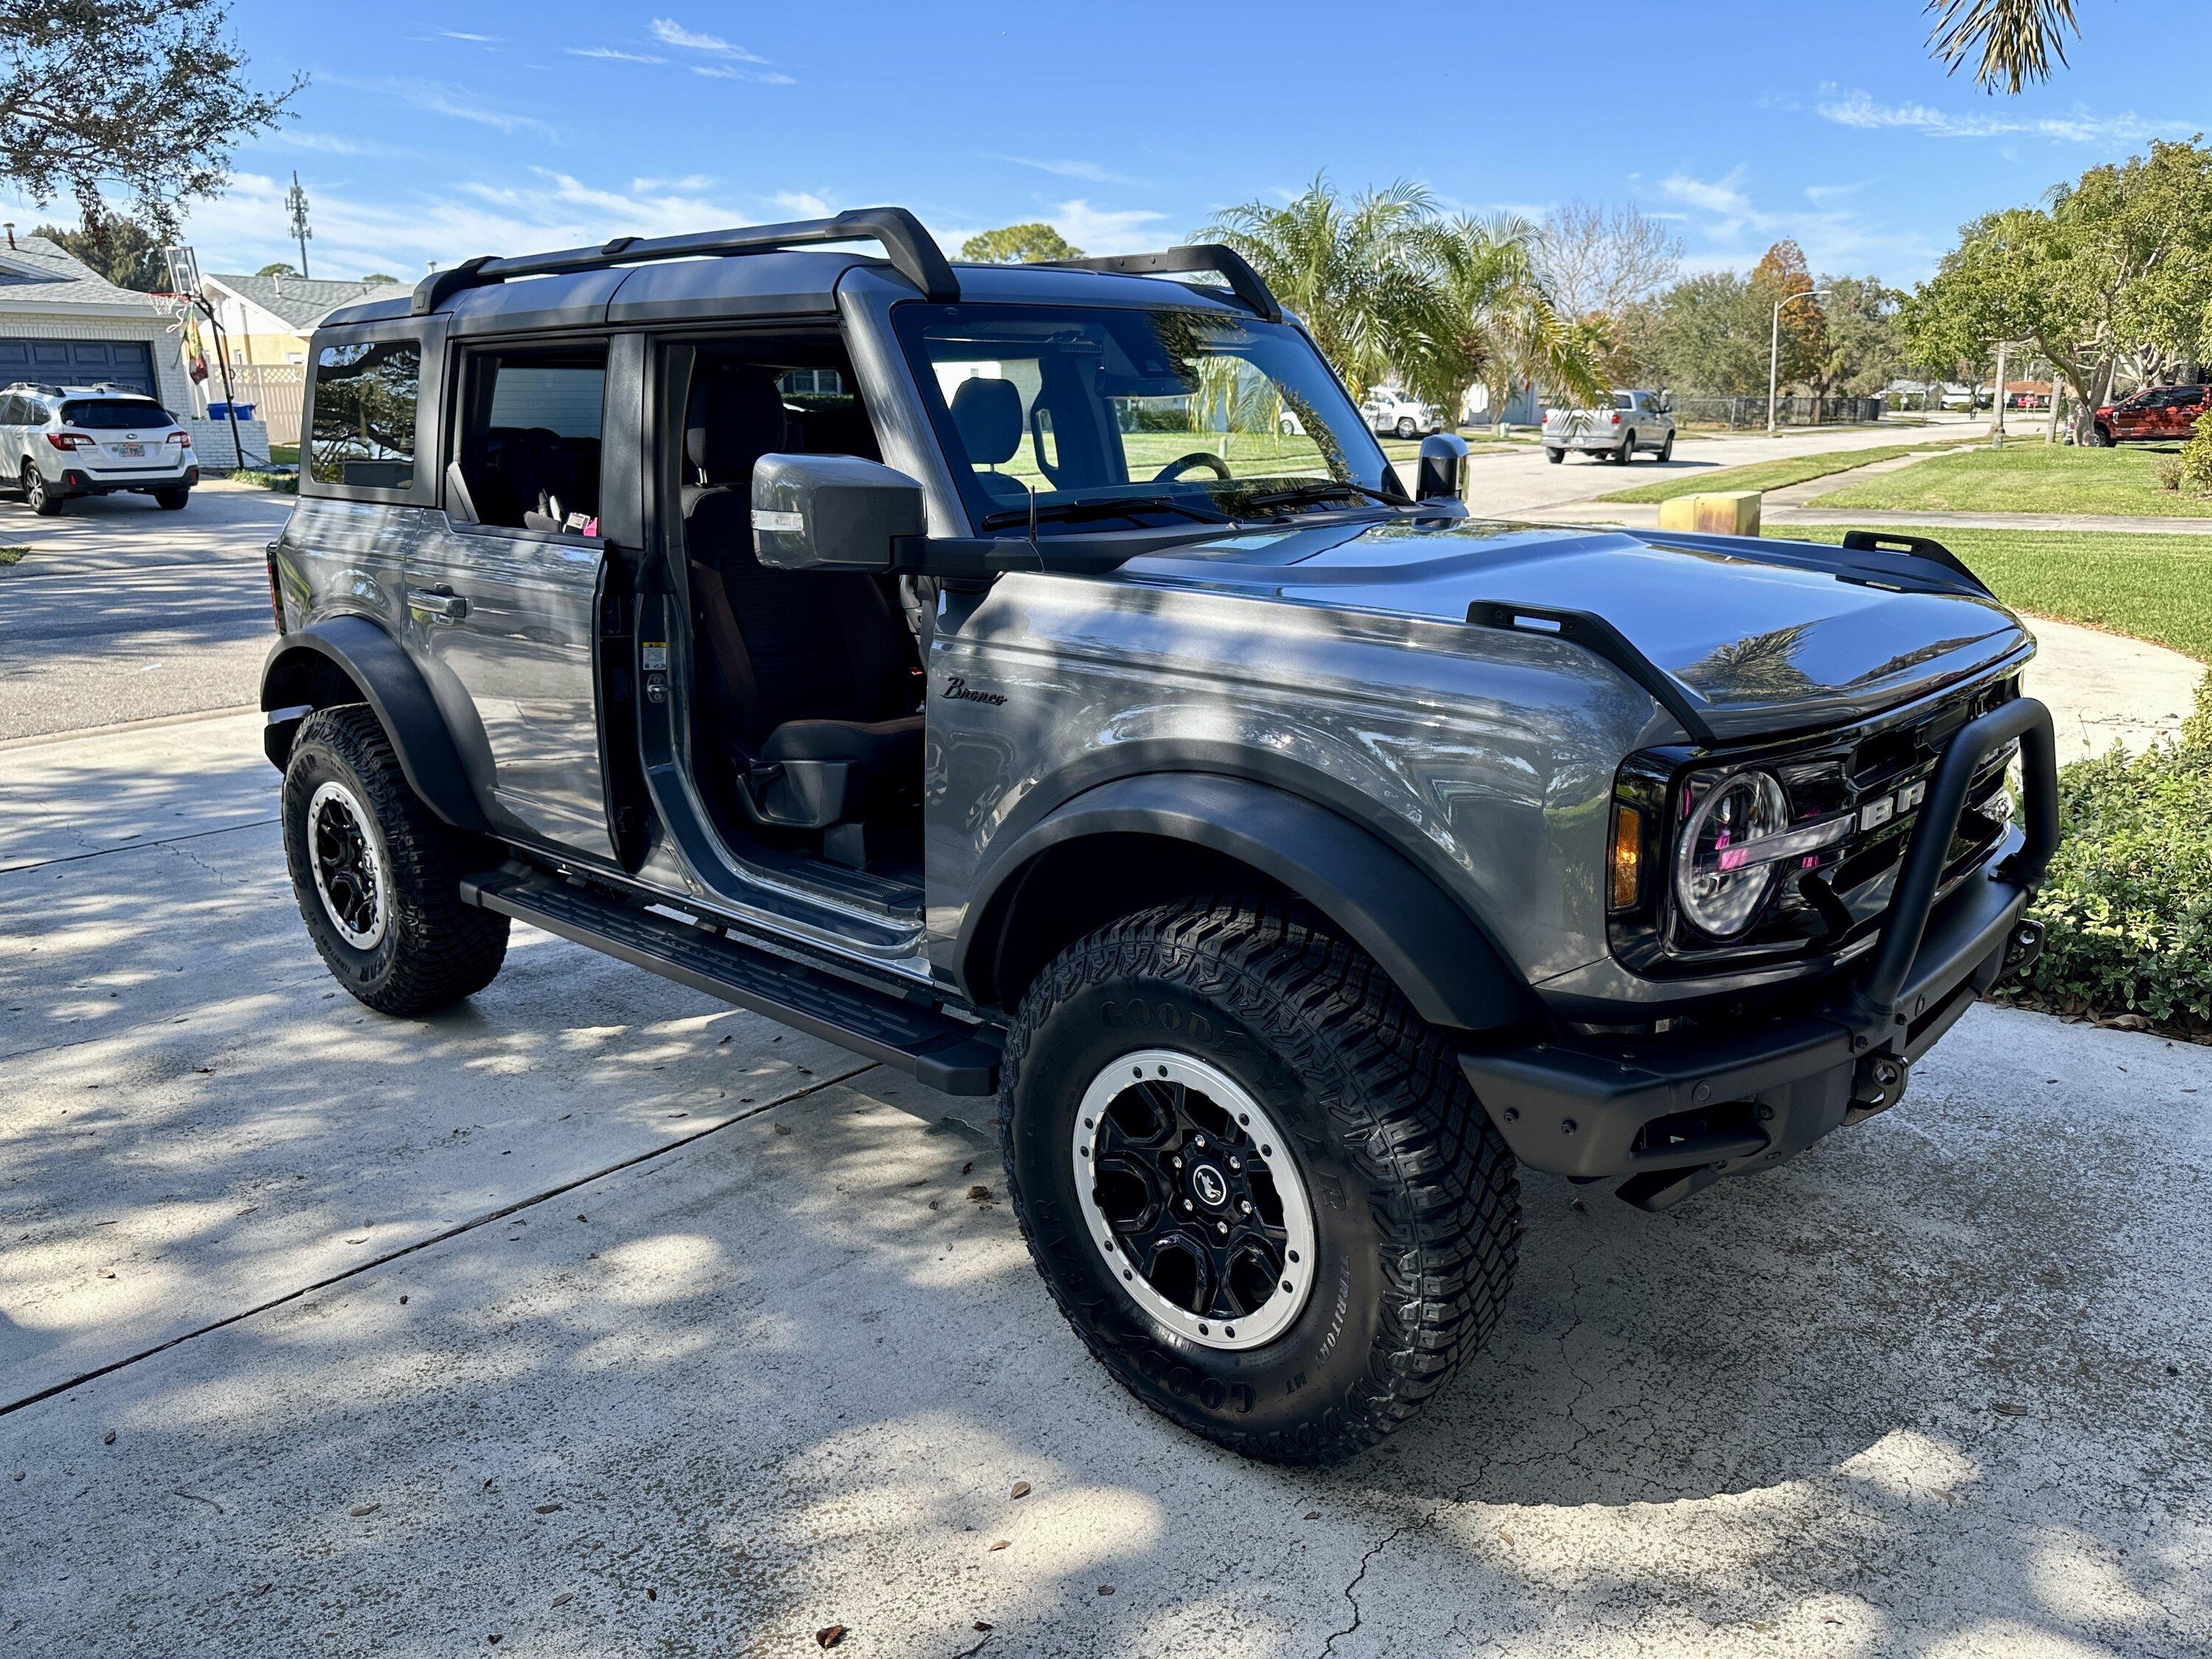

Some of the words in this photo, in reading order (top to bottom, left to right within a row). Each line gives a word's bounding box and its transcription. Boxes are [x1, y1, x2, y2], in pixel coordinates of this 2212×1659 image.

[940, 676, 1008, 706] Bronco
[1315, 1255, 1351, 1370] TERRITORY
[1285, 1370, 1307, 1395] MT
